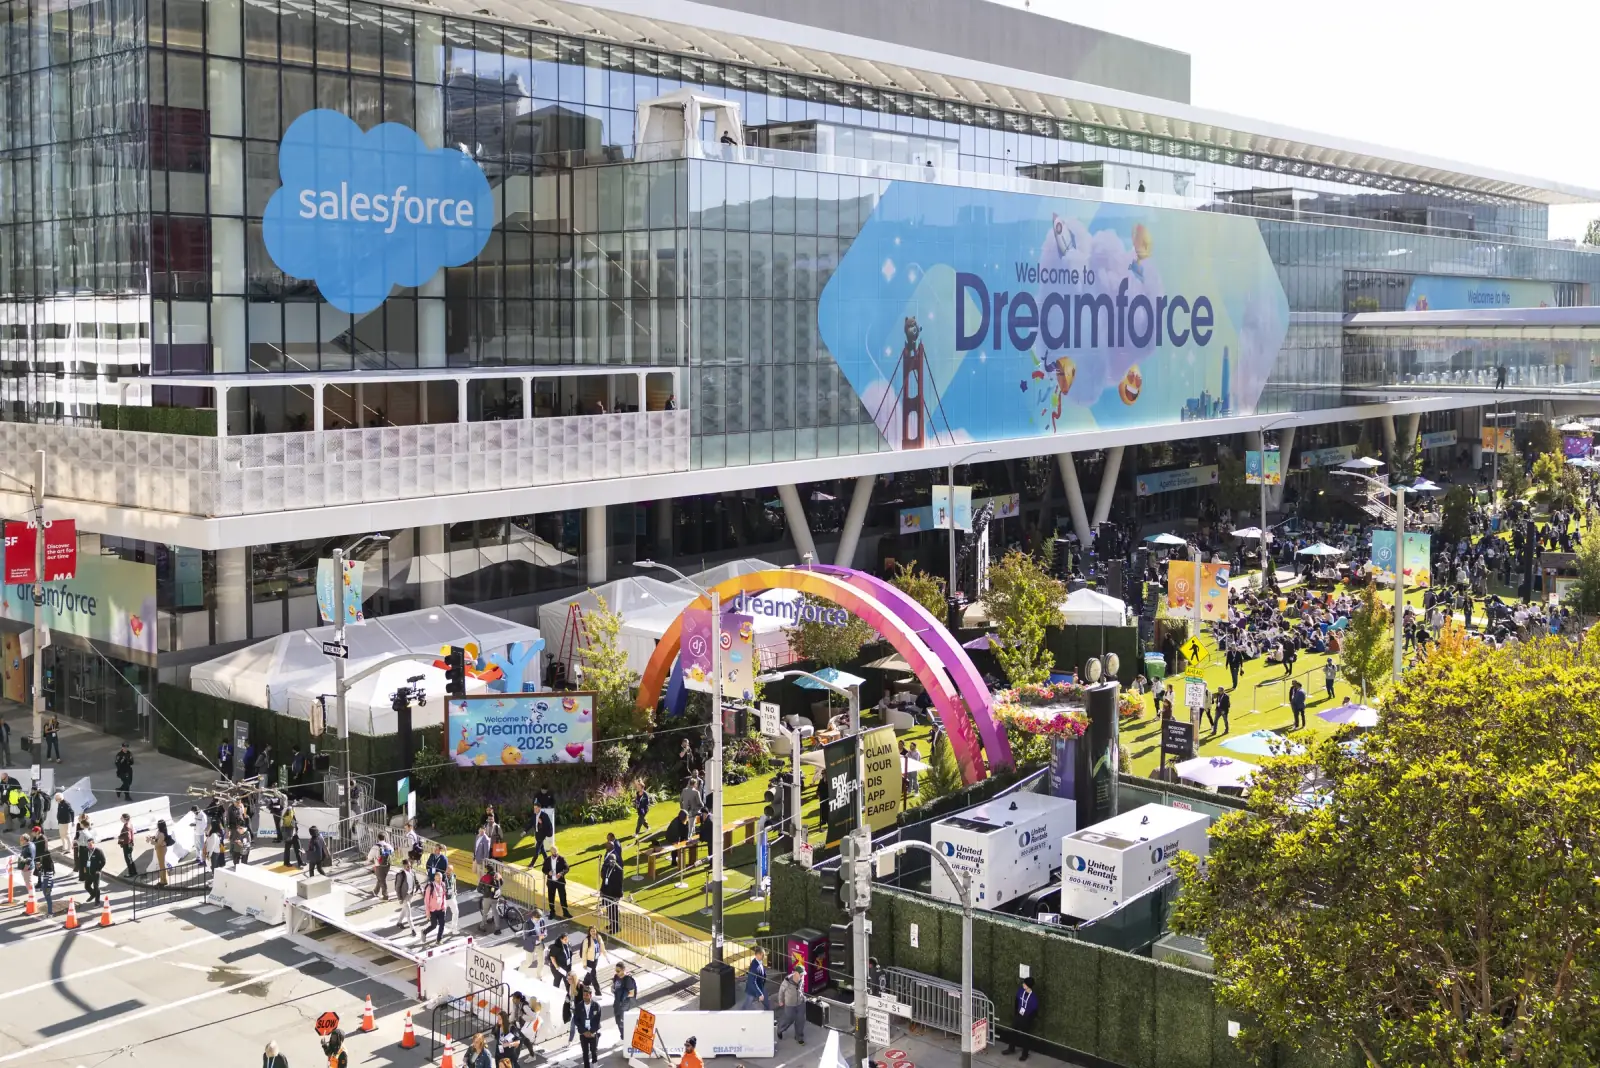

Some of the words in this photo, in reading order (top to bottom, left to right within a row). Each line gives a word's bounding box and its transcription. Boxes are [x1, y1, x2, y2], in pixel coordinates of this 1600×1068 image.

[299, 181, 474, 234] salesforce
[1015, 262, 1079, 285] Welcome
[1082, 266, 1095, 285] to
[1467, 290, 1494, 304] Welcome
[1495, 291, 1501, 303] to
[1502, 291, 1510, 304] the
[955, 277, 1214, 352] Dreamforce
[4, 536, 18, 546] SF
[732, 589, 849, 627] dreamforce
[324, 645, 333, 653] ONE
[476, 723, 568, 736] Dreamforce
[516, 736, 554, 750] 2025
[866, 744, 892, 758] CLAIM
[866, 759, 892, 773] YOUR
[832, 772, 848, 789] BAY
[867, 776, 882, 788] DIS
[836, 778, 858, 798] AREA
[867, 789, 885, 802] APP
[828, 794, 850, 812] THEN
[867, 800, 896, 817] EARED
[1031, 824, 1047, 836] United
[1030, 832, 1048, 844] Rentals
[956, 845, 983, 856] United
[1163, 840, 1179, 852] United
[956, 852, 985, 864] Rentals
[1087, 860, 1116, 872] United
[1087, 868, 1118, 881] Rentals
[474, 955, 495, 974] ROAD
[469, 967, 499, 990] CLOSED
[891, 1004, 900, 1012] St
[317, 1019, 336, 1029] SLOW
